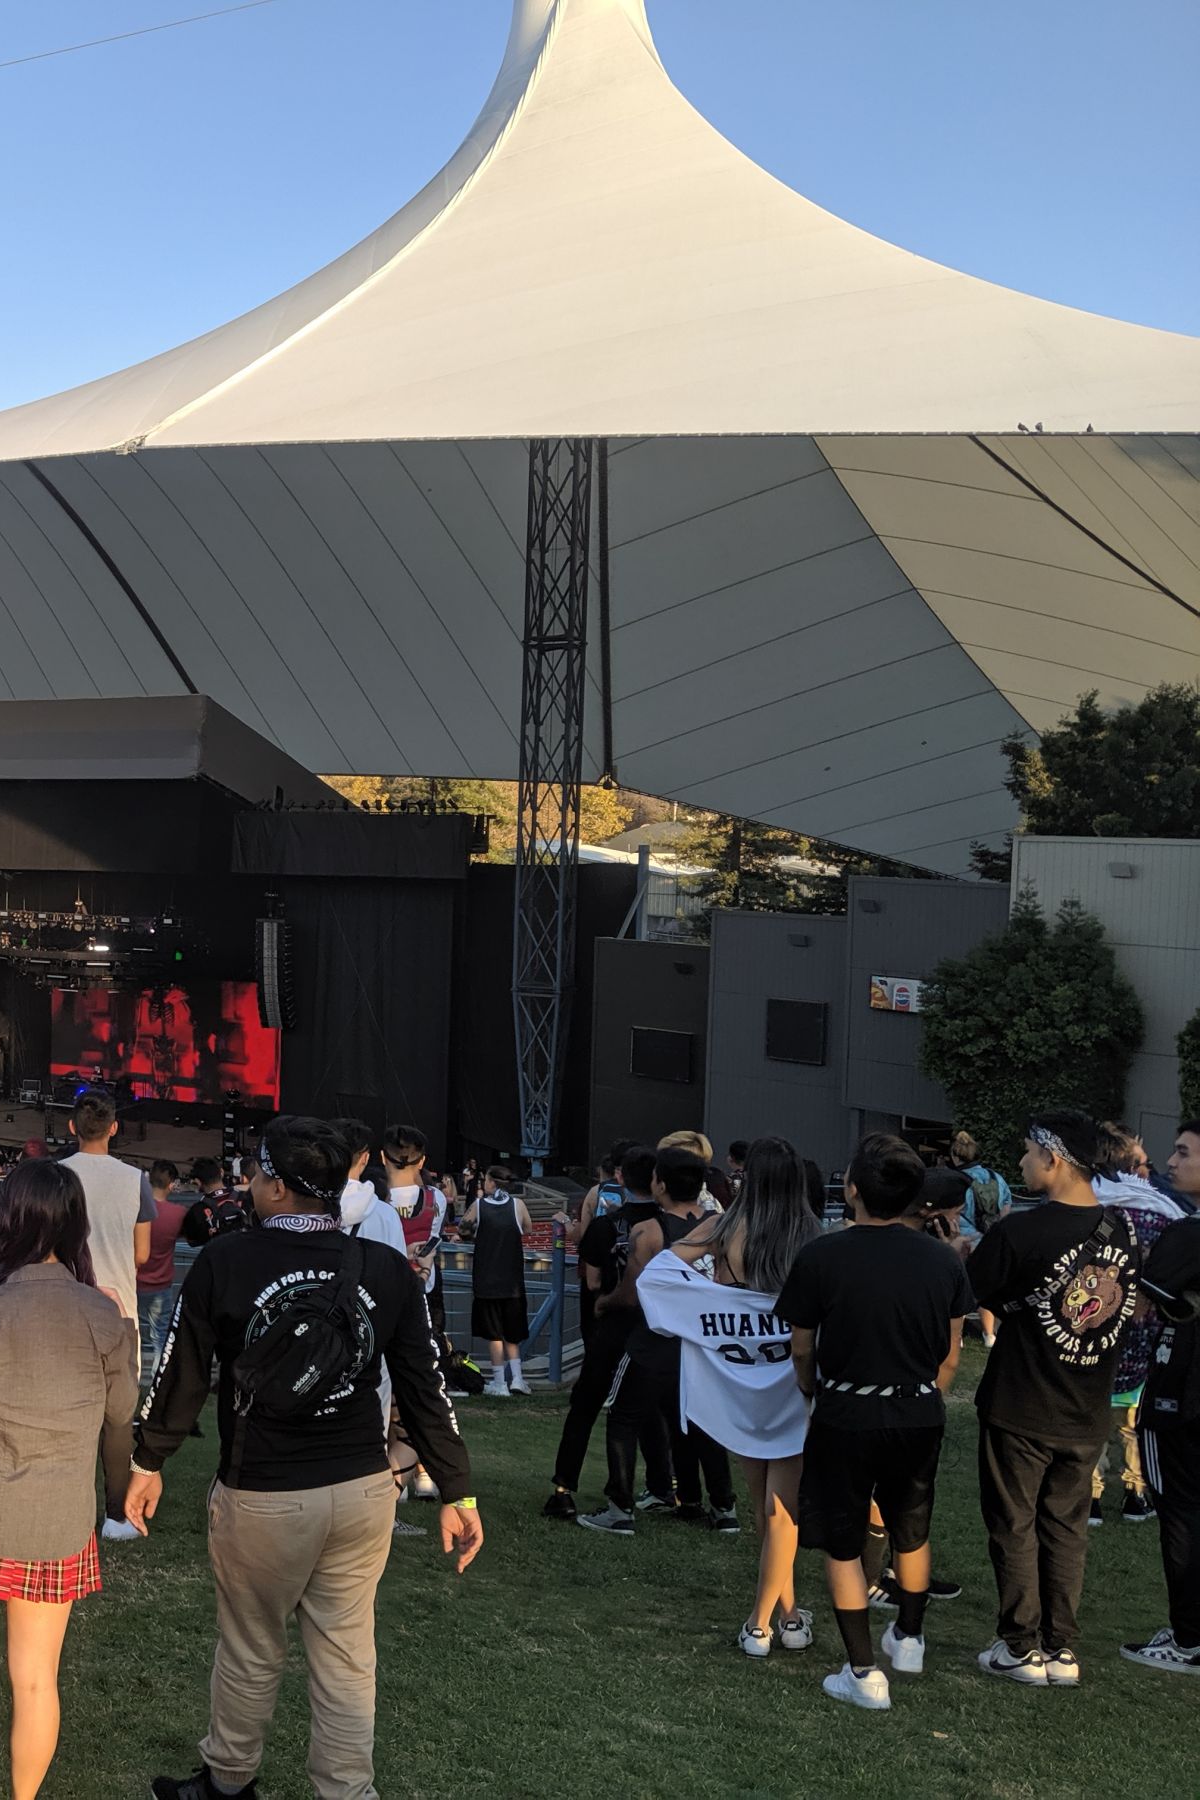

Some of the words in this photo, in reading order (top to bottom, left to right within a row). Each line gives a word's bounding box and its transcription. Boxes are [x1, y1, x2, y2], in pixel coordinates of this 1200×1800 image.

[254, 1281, 281, 1308] HERE
[281, 1271, 305, 1286] FOR
[306, 1269, 316, 1280] A
[700, 1312, 792, 1337] HUANG
[1080, 1354, 1100, 1365] 2015
[293, 1372, 311, 1392] adidas
[140, 1386, 156, 1421] NOT
